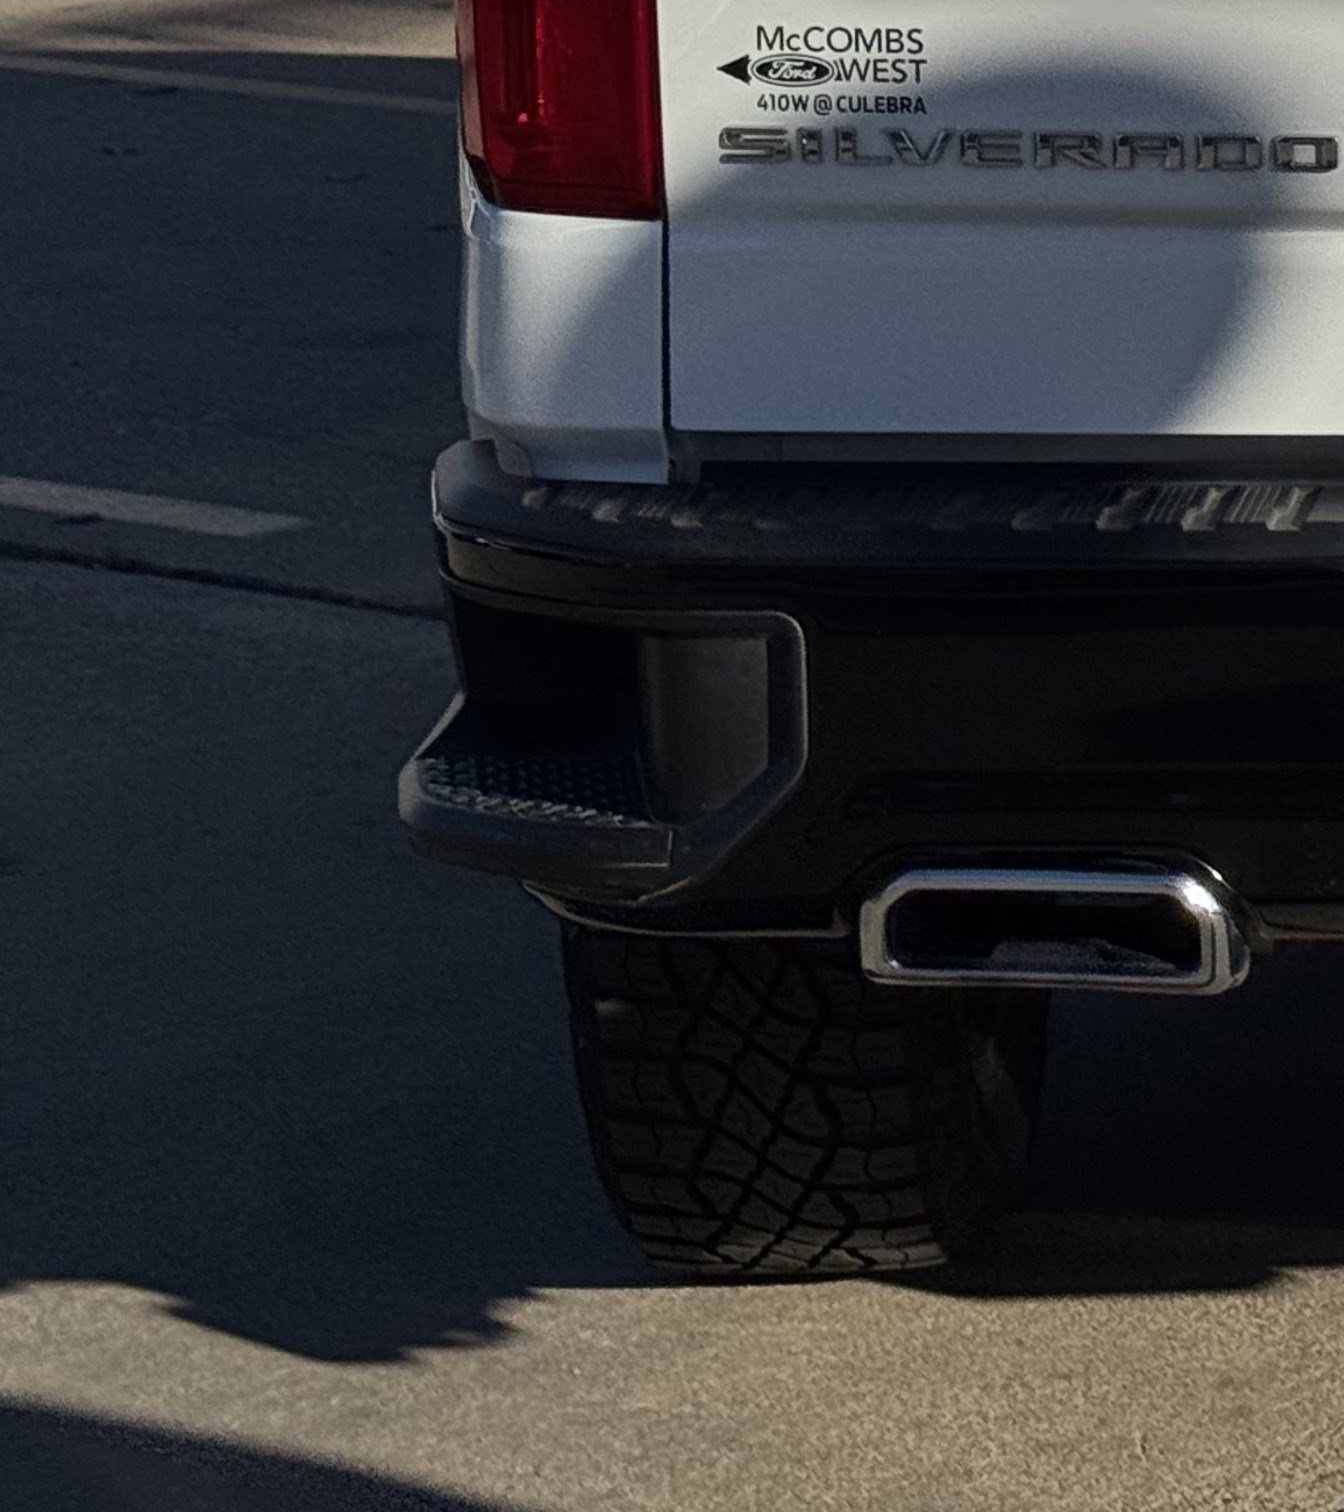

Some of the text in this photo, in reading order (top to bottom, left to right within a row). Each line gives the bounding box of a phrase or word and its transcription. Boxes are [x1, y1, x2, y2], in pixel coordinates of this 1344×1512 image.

[756, 25, 924, 54] McCOMBS
[767, 58, 928, 84] Ford WEST
[756, 93, 928, 116] 410W @ CULEBRA
[718, 126, 1340, 174] SILVERADO
